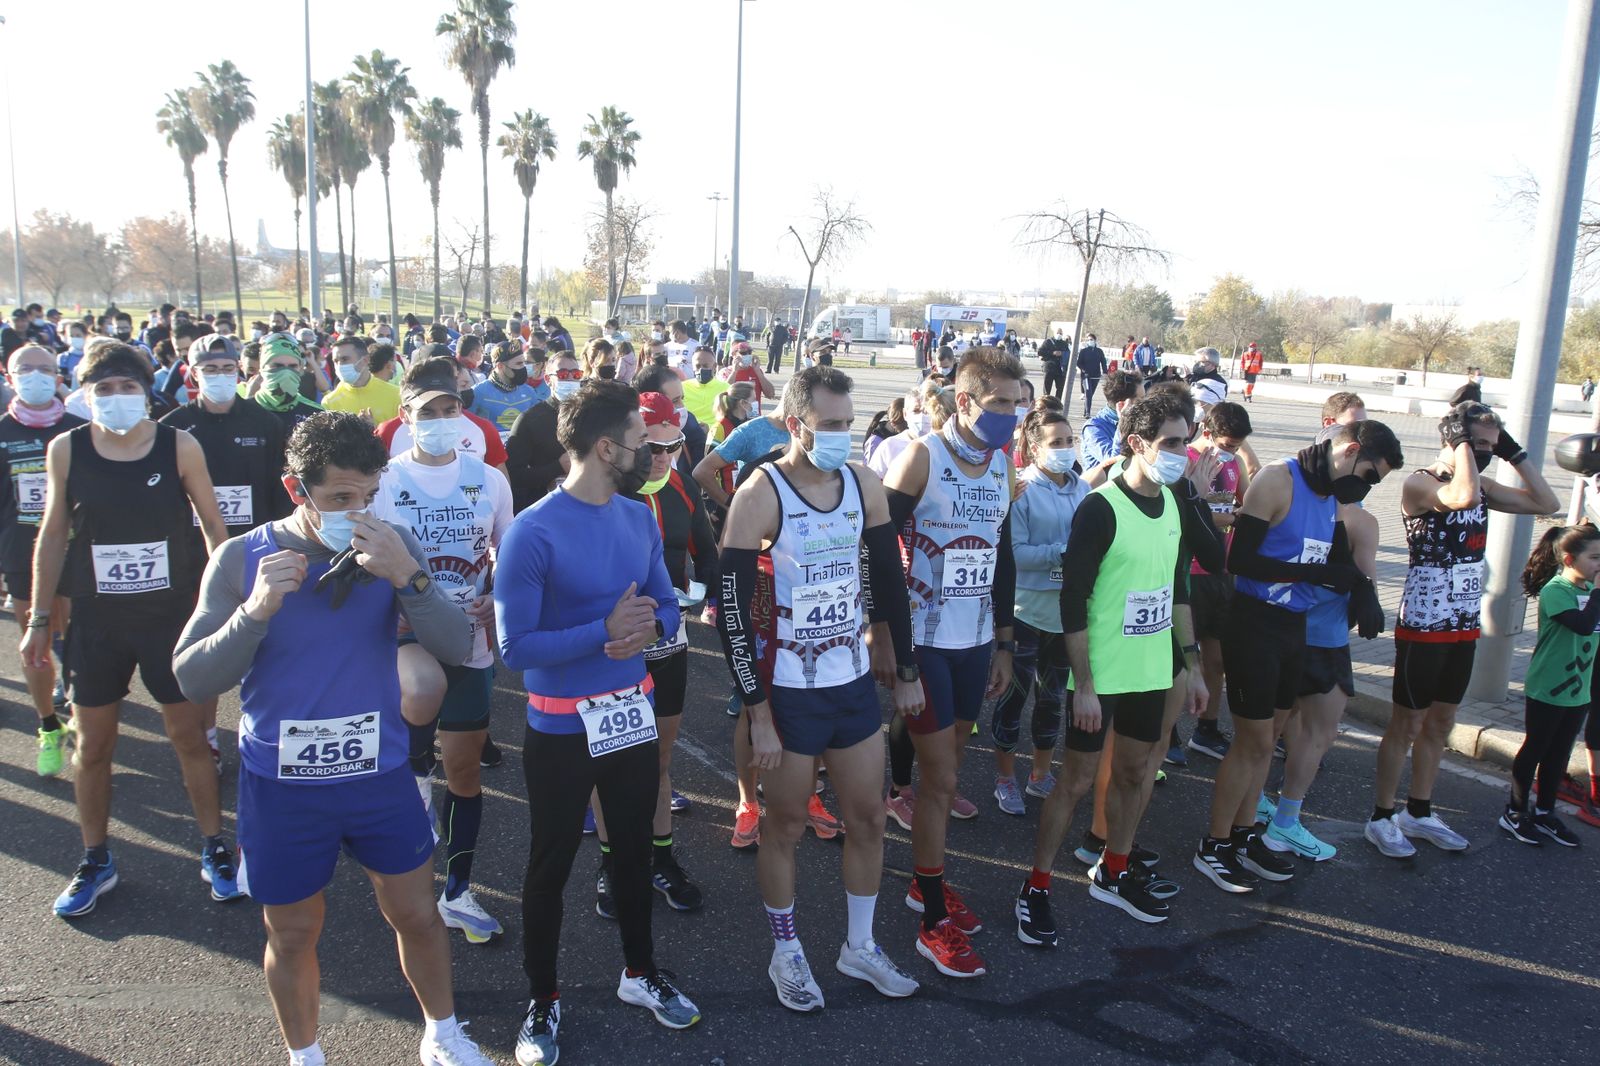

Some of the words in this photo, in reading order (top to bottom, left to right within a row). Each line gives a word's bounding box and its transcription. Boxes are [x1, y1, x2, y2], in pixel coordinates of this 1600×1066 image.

[217, 501, 241, 515] 27
[108, 561, 155, 580] 457
[434, 573, 464, 585] RDOBA
[954, 567, 988, 586] 314
[110, 579, 167, 591] CORDOBARIA
[1462, 577, 1481, 592] 38
[806, 600, 848, 625] 443
[1135, 603, 1166, 624] 311
[796, 630, 808, 638] LA
[809, 622, 854, 637] CORDOBARIA
[599, 708, 643, 735] 498
[591, 743, 603, 753] LA
[603, 728, 655, 750] CORDOBARIA
[297, 739, 363, 764] 456
[299, 761, 374, 776] CORDOBARI
